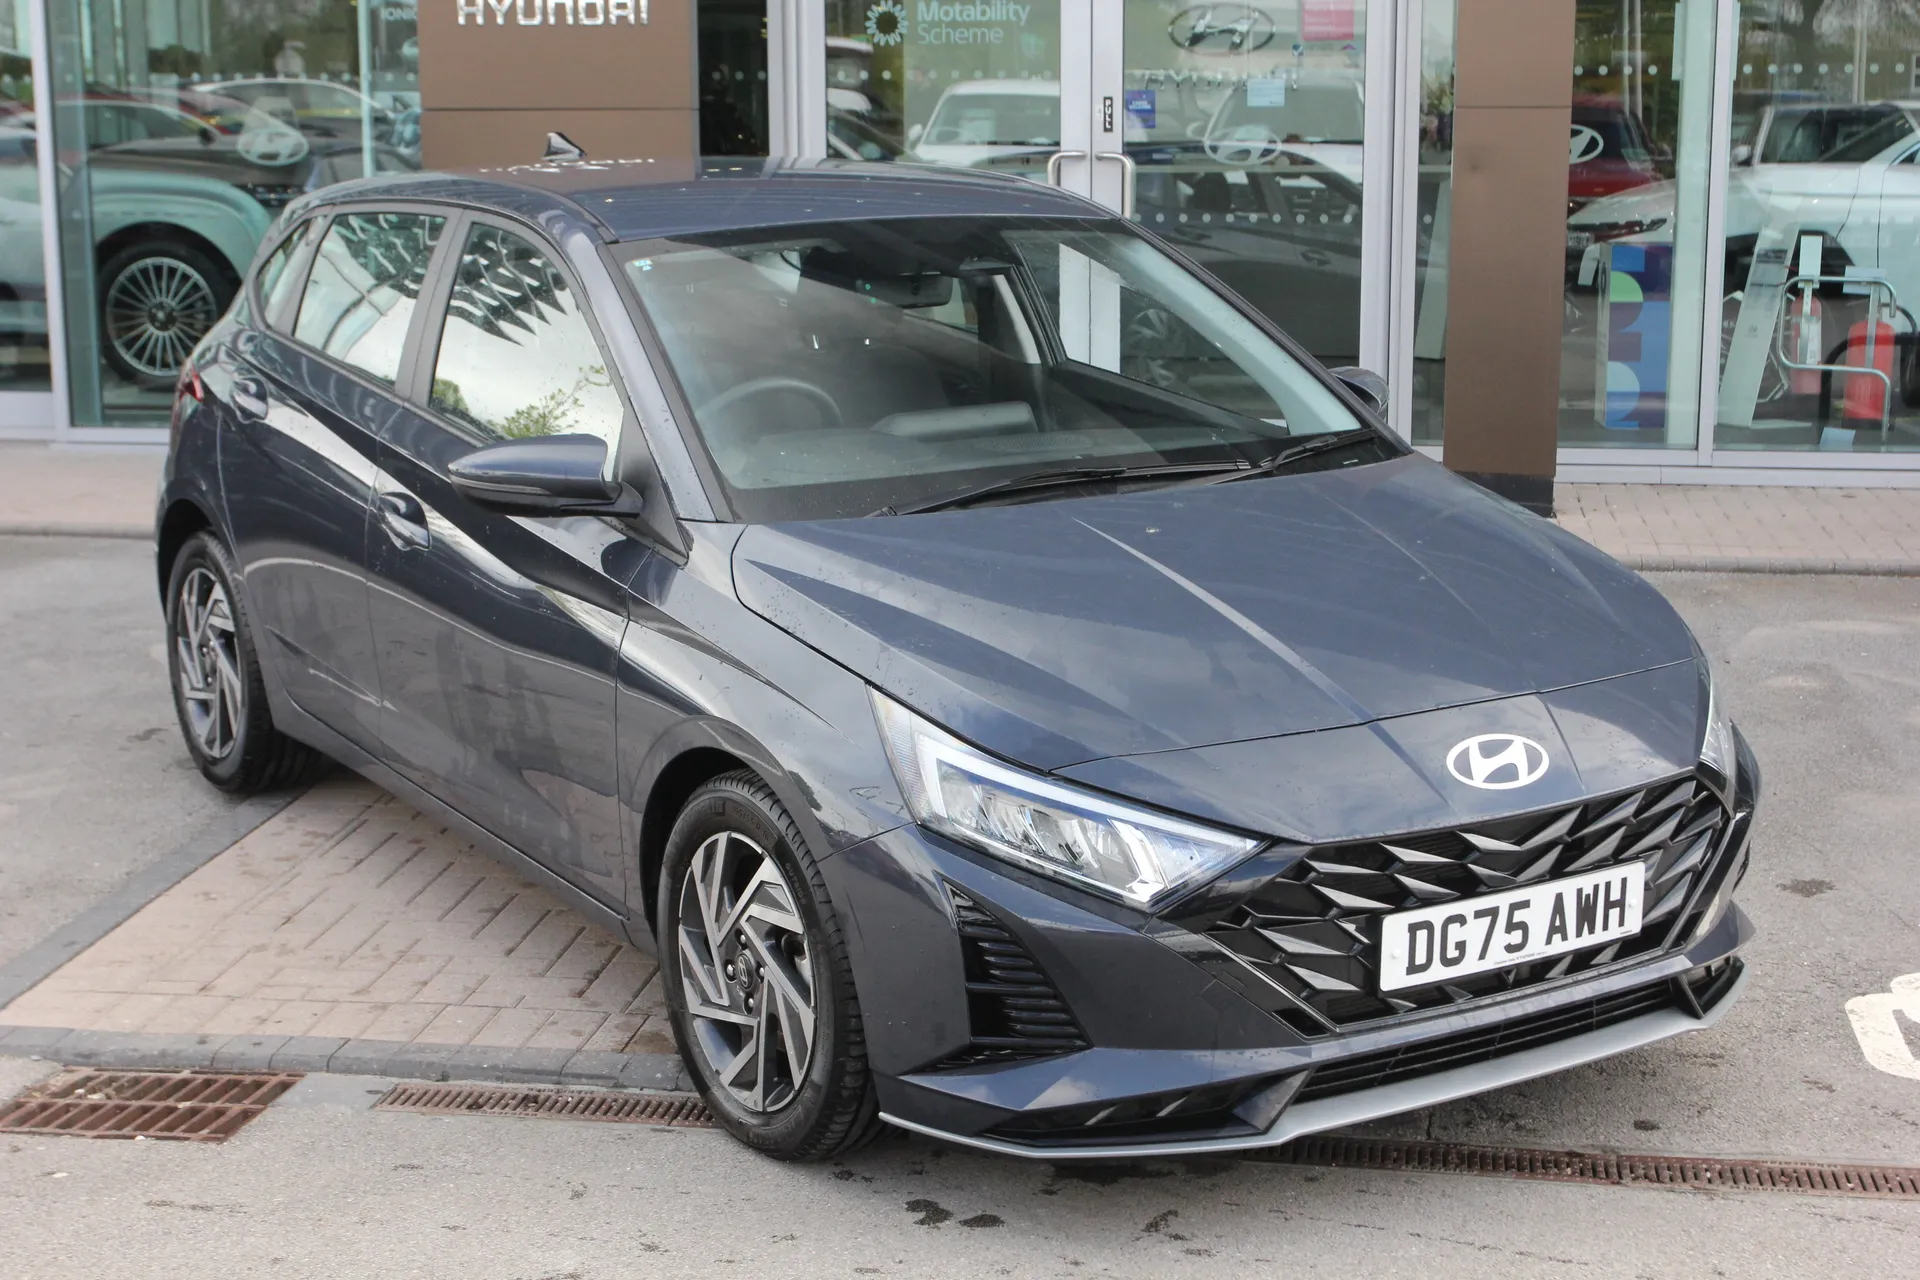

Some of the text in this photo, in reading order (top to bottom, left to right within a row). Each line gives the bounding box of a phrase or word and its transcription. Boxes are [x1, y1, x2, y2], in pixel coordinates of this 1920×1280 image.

[456, 0, 649, 25] HYUNDAI
[917, 0, 1031, 26] Motability
[917, 24, 1004, 45] Scheme
[1406, 877, 1628, 976] DG75 AWH
